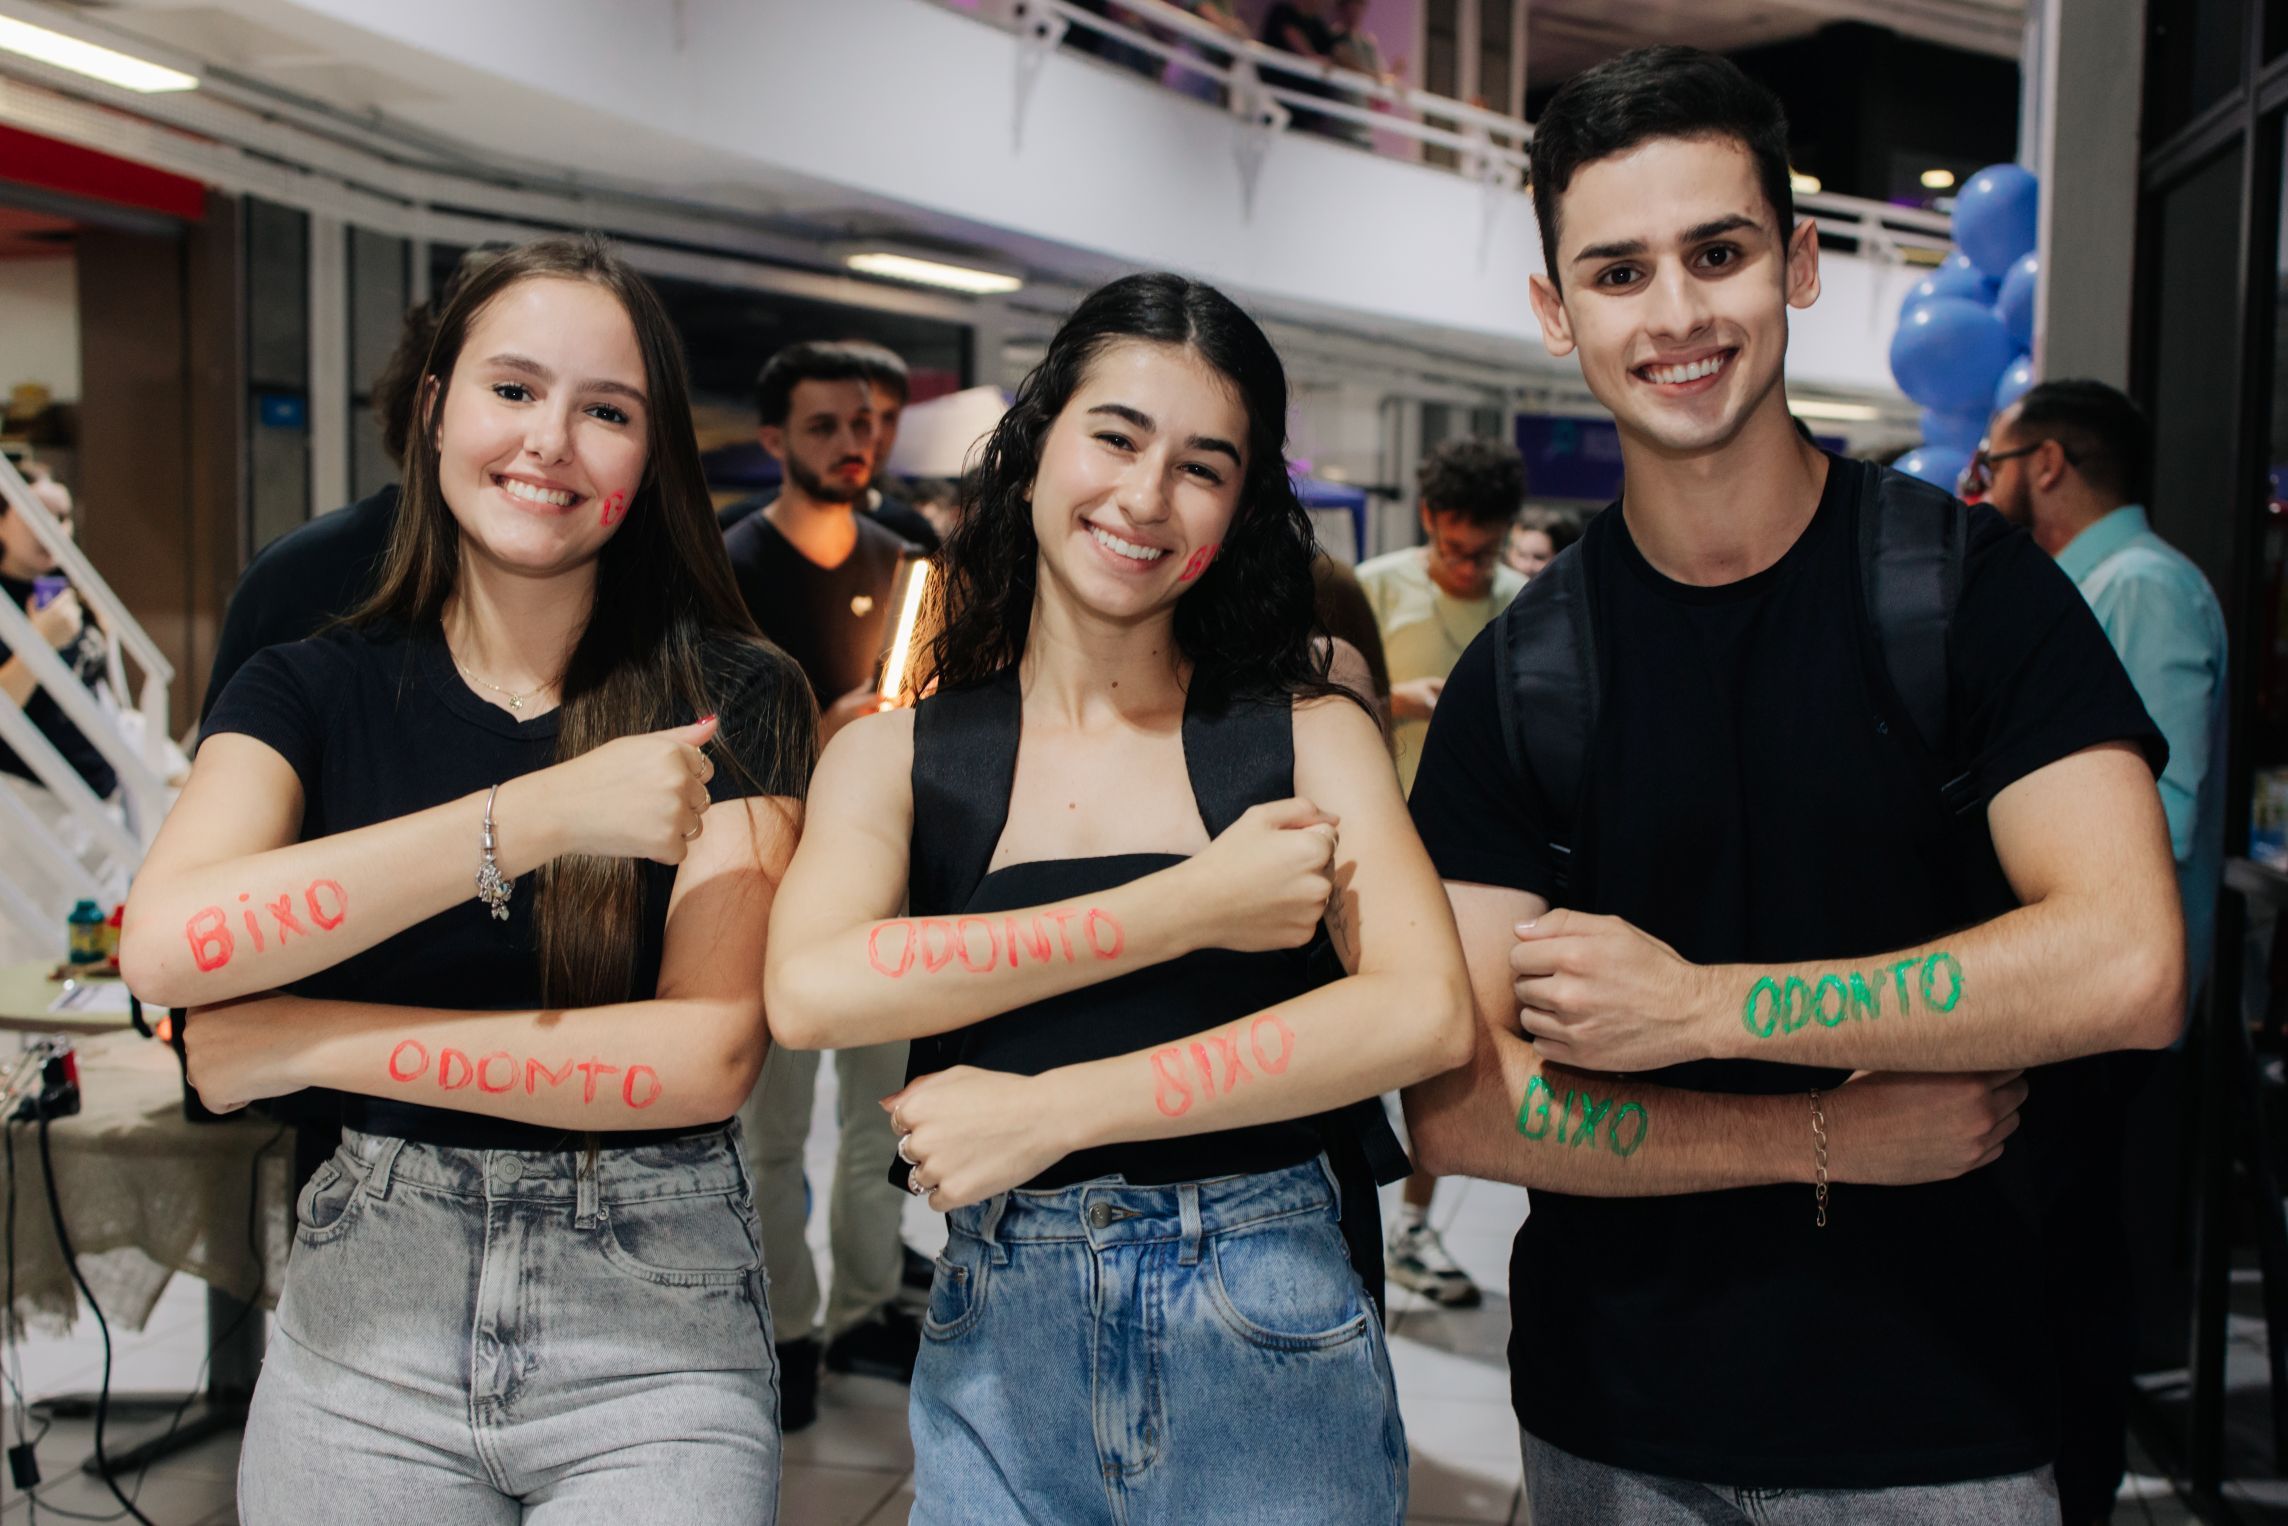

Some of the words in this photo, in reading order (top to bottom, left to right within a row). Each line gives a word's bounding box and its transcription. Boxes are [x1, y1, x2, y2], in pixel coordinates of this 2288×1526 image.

[868, 907, 1125, 978] ODONTO
[1741, 952, 1965, 1039] ODONTO
[389, 1039, 662, 1109] ODONTO
